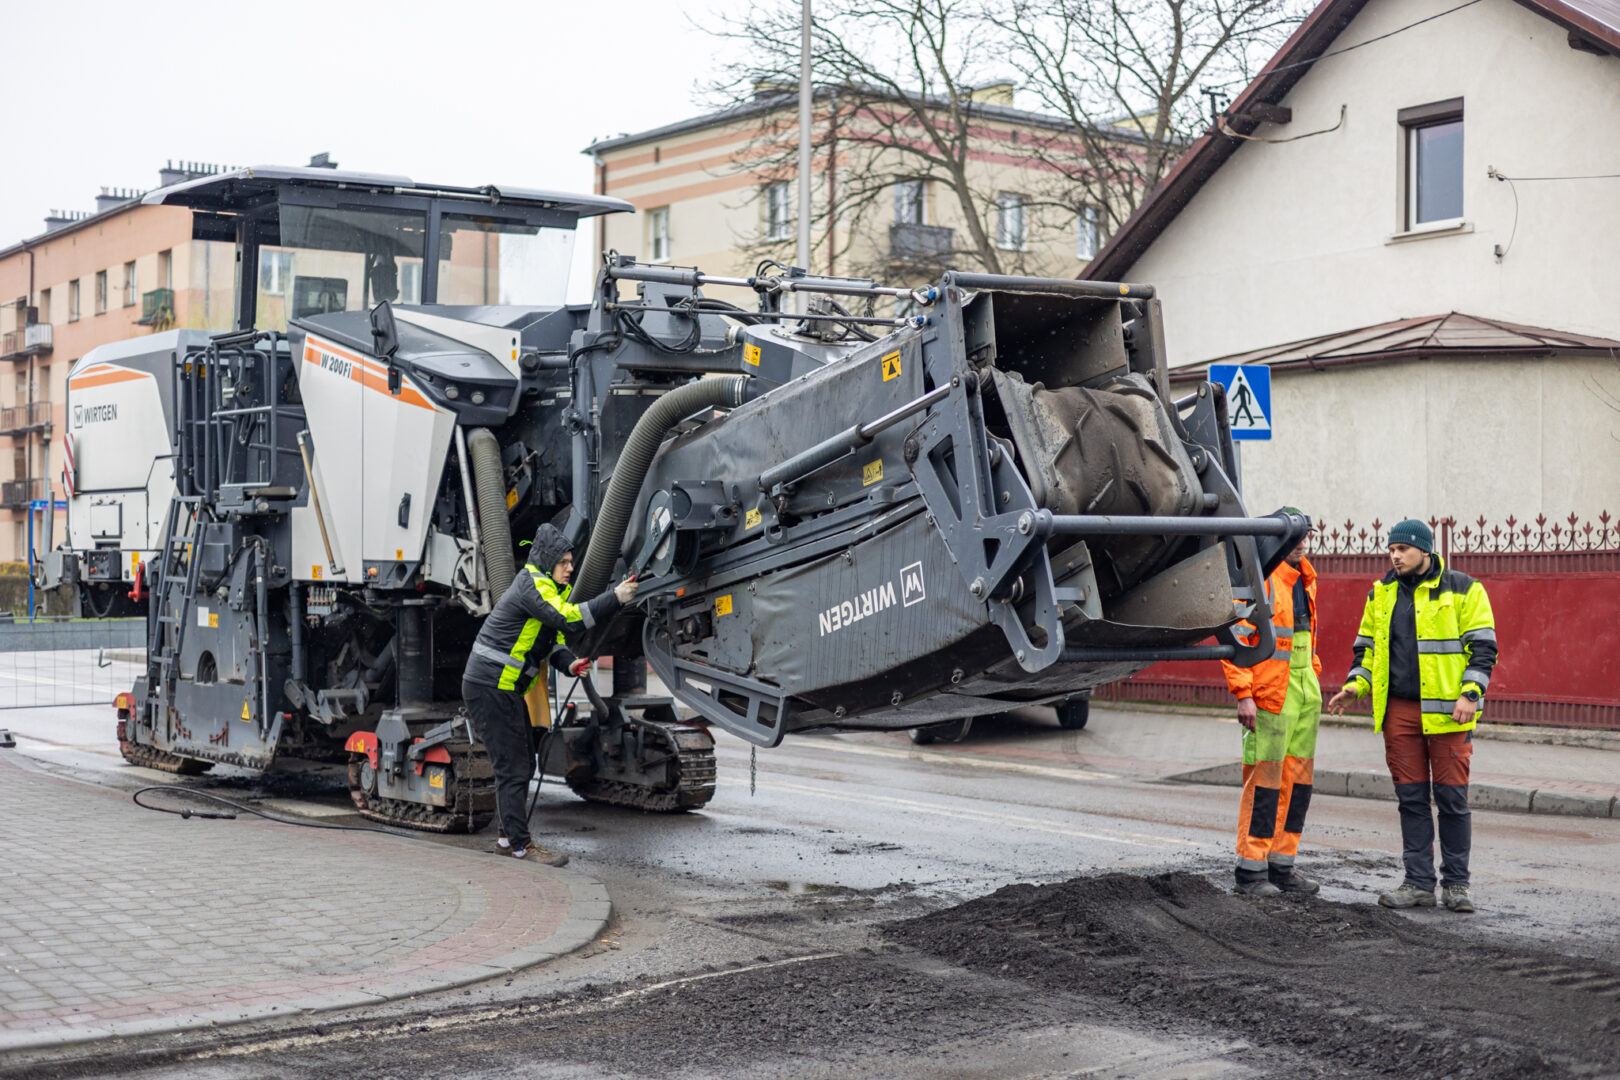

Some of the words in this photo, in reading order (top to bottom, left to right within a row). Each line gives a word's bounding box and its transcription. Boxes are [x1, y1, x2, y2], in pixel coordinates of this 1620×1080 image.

[321, 353, 329, 369] W
[329, 356, 351, 379] 200Fi
[84, 404, 117, 424] WIRTGEN
[819, 581, 897, 637] WIRTGEN
